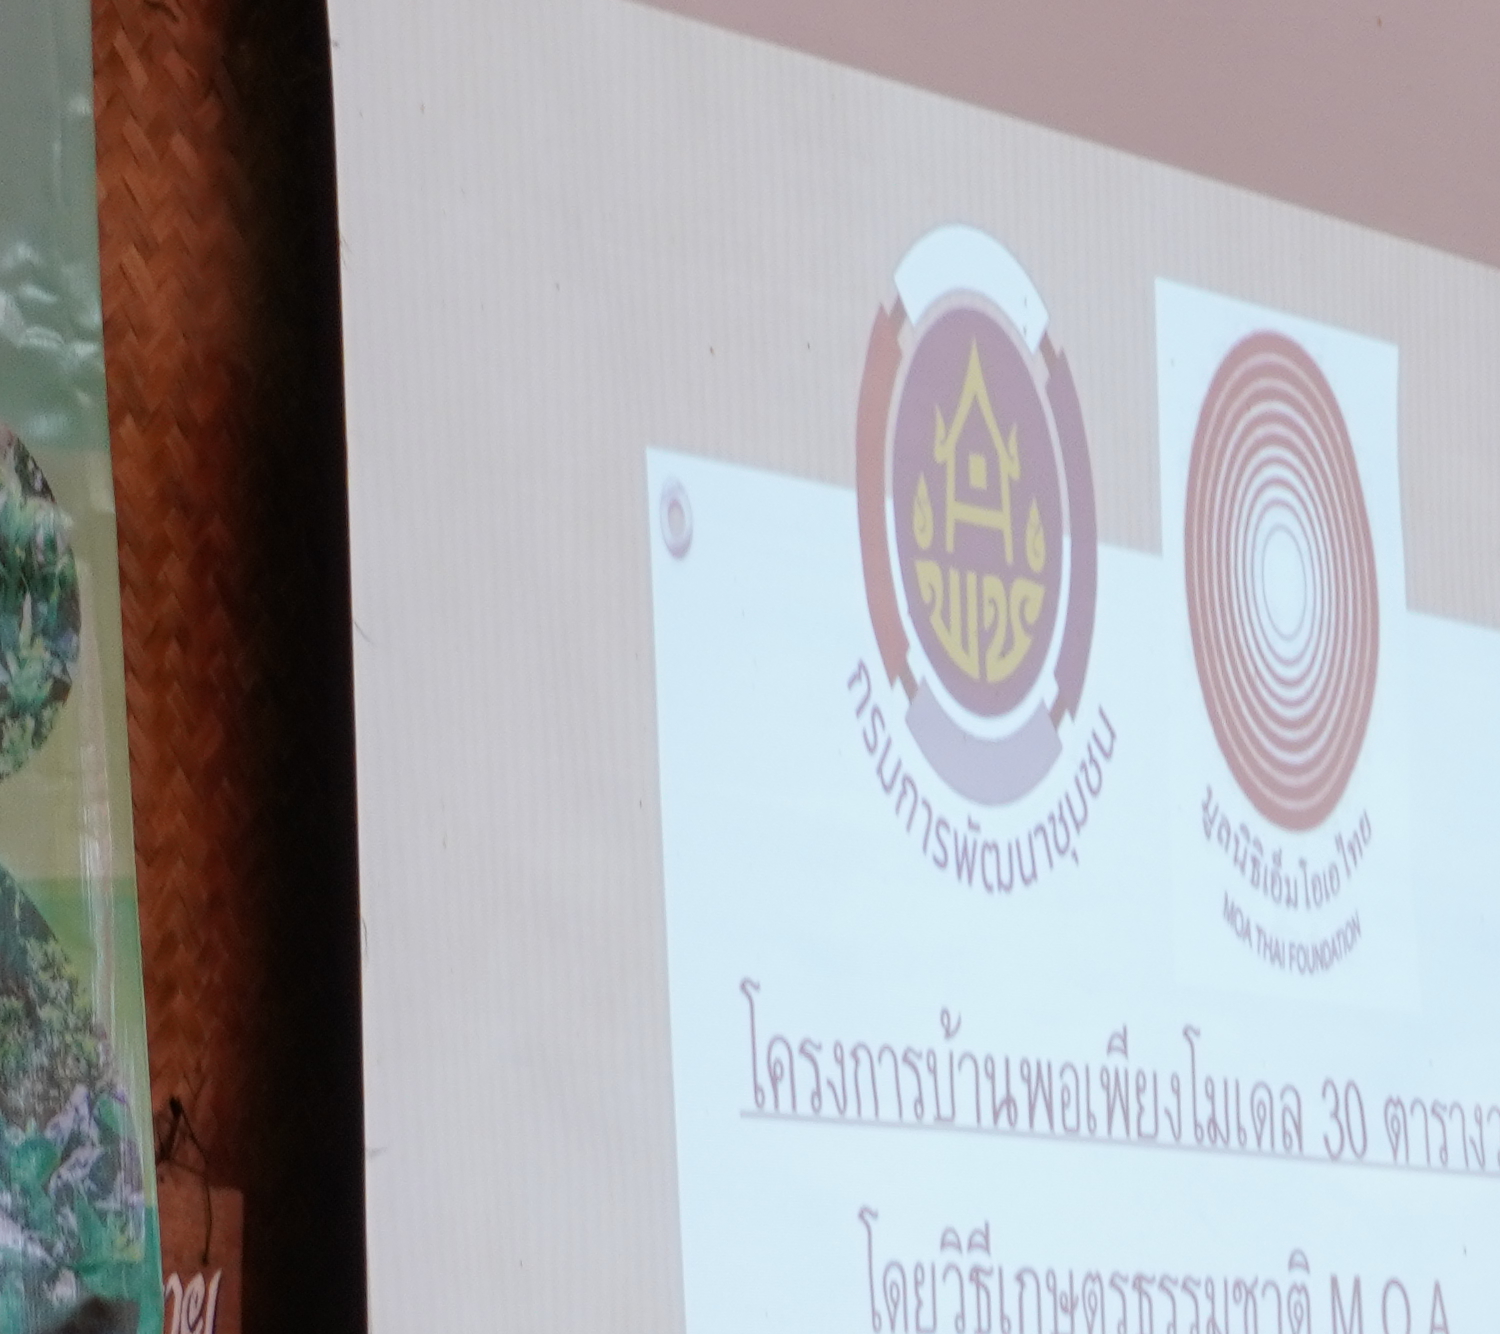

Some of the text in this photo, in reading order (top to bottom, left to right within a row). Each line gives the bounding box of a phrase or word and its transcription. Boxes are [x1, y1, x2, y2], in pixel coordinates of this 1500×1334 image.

[846, 658, 1117, 895] กรมการพัฒนาชุมชน
[1222, 890, 1362, 977] MOA THAI FOUNDATION
[738, 978, 1306, 1154] โครงการบ้านพอเพียงโมเดล
[1321, 1078, 1368, 1161] 30
